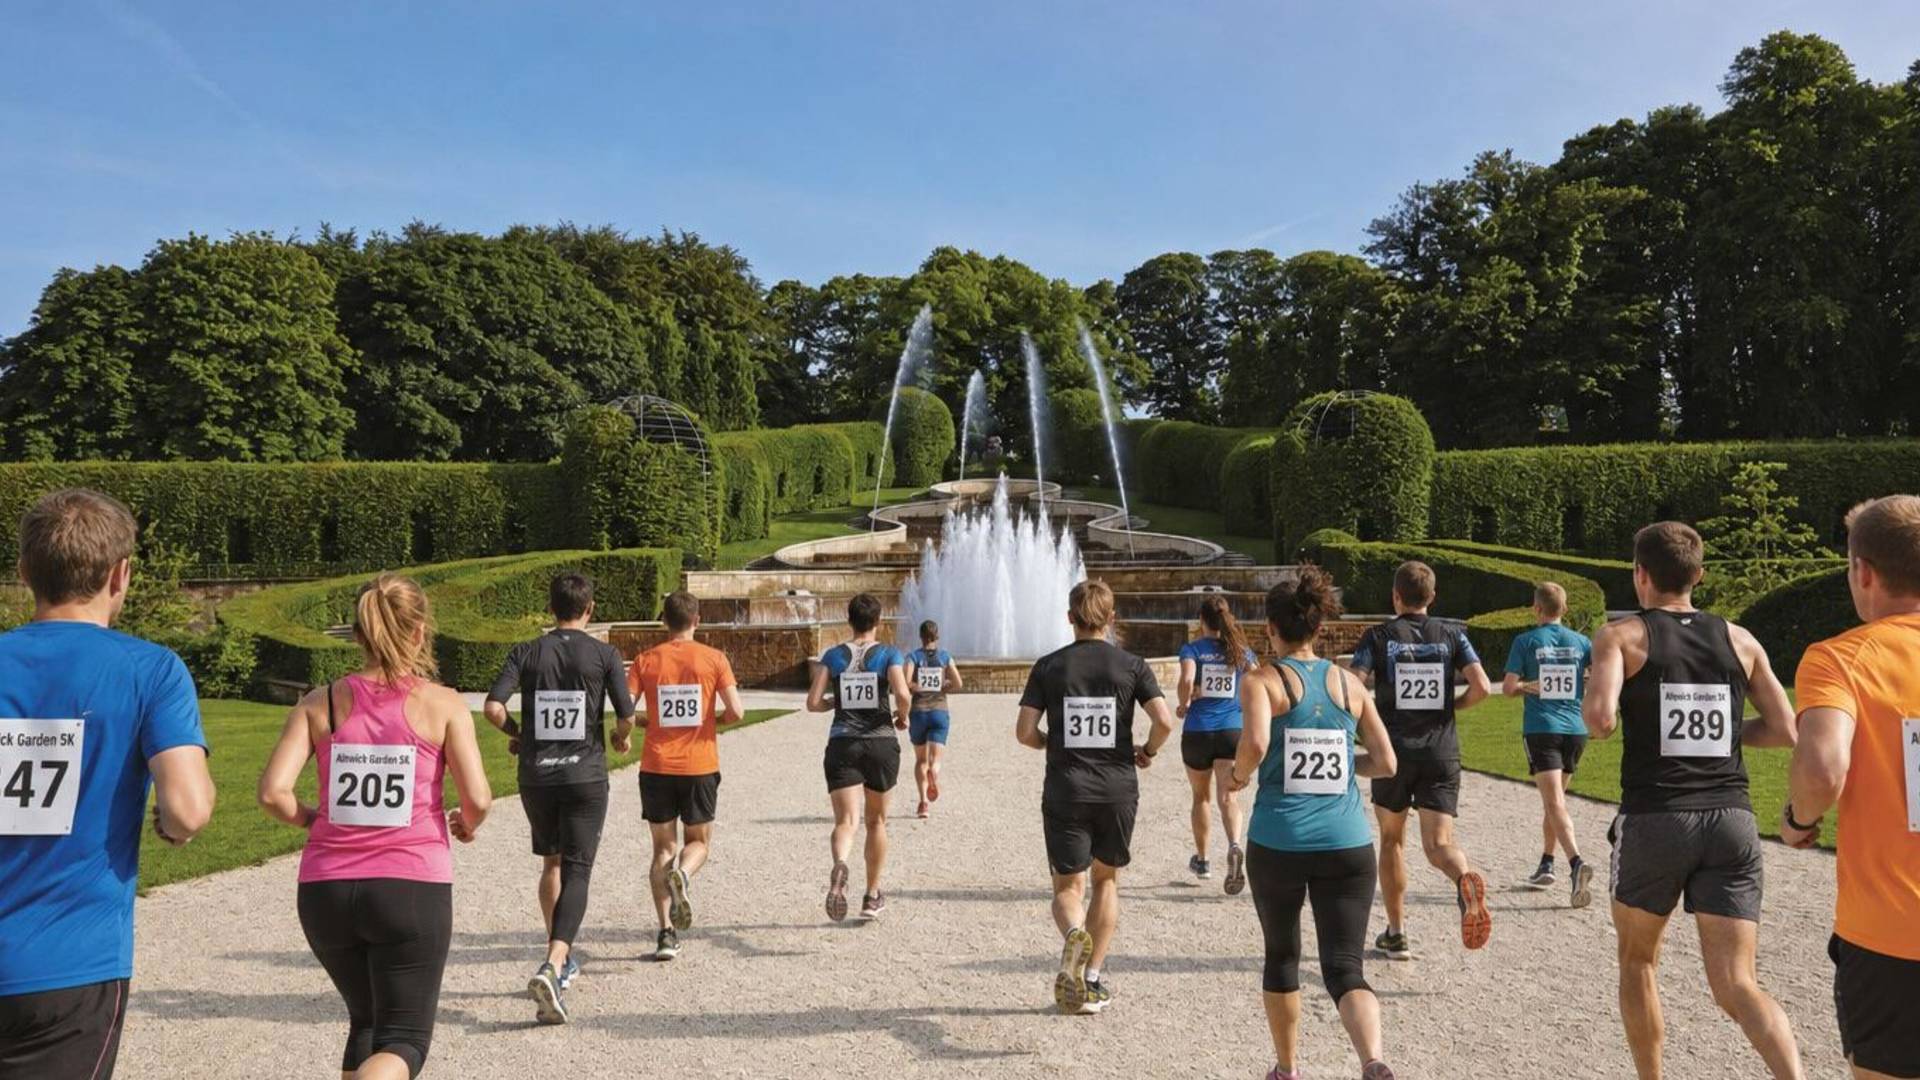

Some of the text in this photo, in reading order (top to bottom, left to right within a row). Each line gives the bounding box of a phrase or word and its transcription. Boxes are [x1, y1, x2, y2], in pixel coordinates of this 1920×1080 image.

[845, 685, 874, 701] 178
[1400, 679, 1439, 700] 223
[1543, 676, 1573, 693] 315
[540, 708, 580, 729] 187
[1069, 715, 1111, 737] 316
[1667, 709, 1725, 740] 289
[17, 732, 57, 746] Garden
[60, 732, 75, 746] 5K
[1290, 751, 1342, 780] 223
[0, 760, 69, 808] 47
[336, 772, 405, 808] 205
